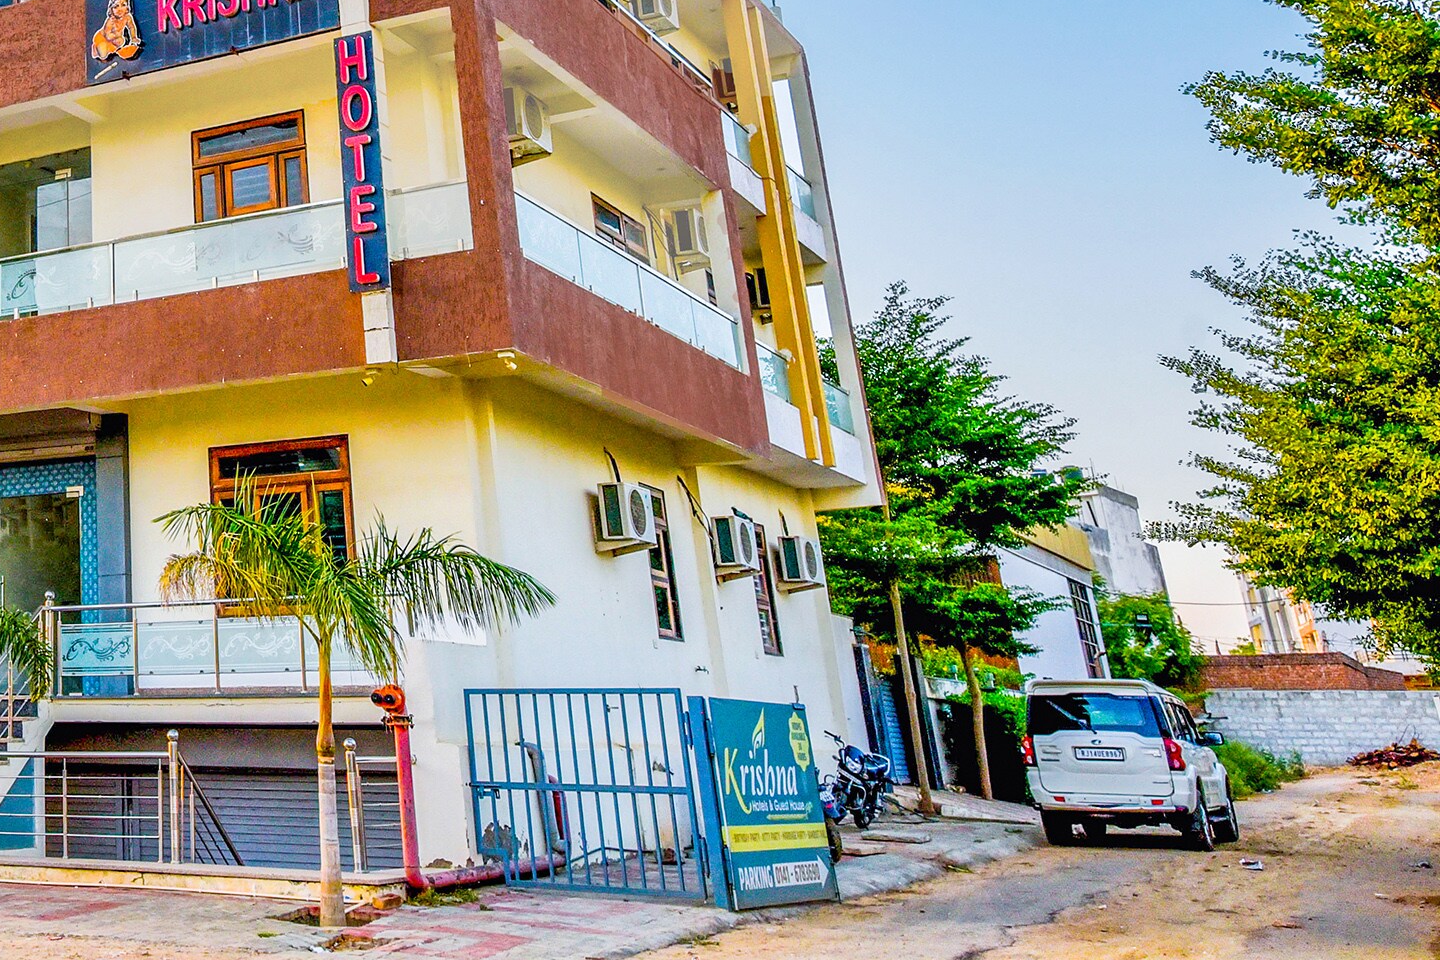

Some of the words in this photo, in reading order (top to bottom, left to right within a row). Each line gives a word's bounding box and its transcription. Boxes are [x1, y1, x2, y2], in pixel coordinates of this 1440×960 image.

[337, 35, 381, 285] HOTEL
[724, 746, 799, 814] Krishna
[738, 865, 774, 891] PARKING
